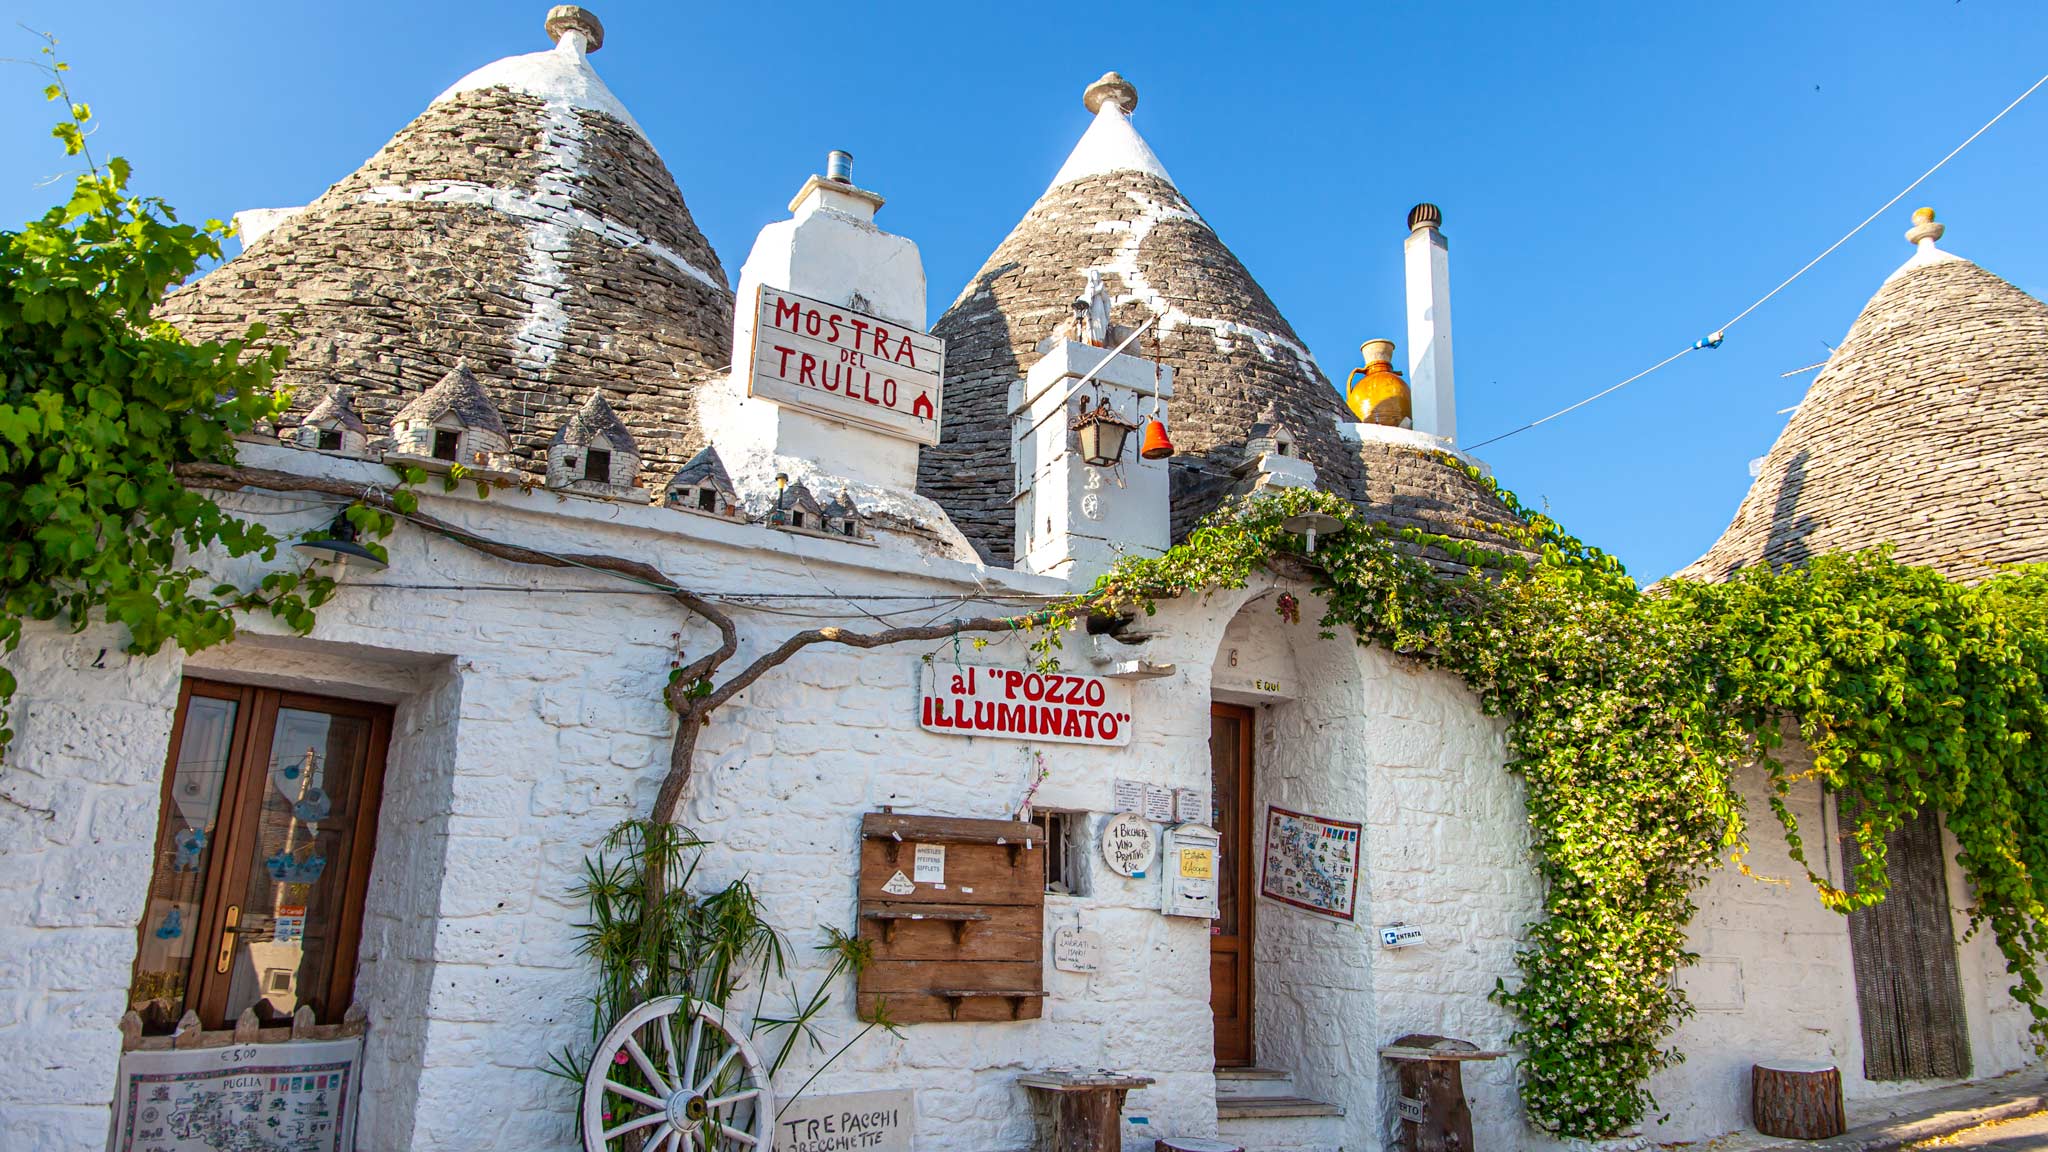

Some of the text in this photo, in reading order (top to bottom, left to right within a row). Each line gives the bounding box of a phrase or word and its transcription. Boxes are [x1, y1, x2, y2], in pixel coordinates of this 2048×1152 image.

[775, 296, 916, 368] MOSTRA
[840, 348, 866, 369] DEL
[774, 345, 897, 408] TRULLO
[1231, 650, 1238, 667] 6
[950, 667, 1106, 708] al "POZZO
[922, 696, 1131, 741] ILLUMINATO"
[1113, 826, 1118, 838] 1
[1116, 839, 1133, 850] VINO
[1396, 931, 1421, 940] ENTRATA
[221, 1049, 257, 1062] € 5,00
[223, 1077, 262, 1089] PUGLIA
[782, 1109, 898, 1143] TRE PACCHI
